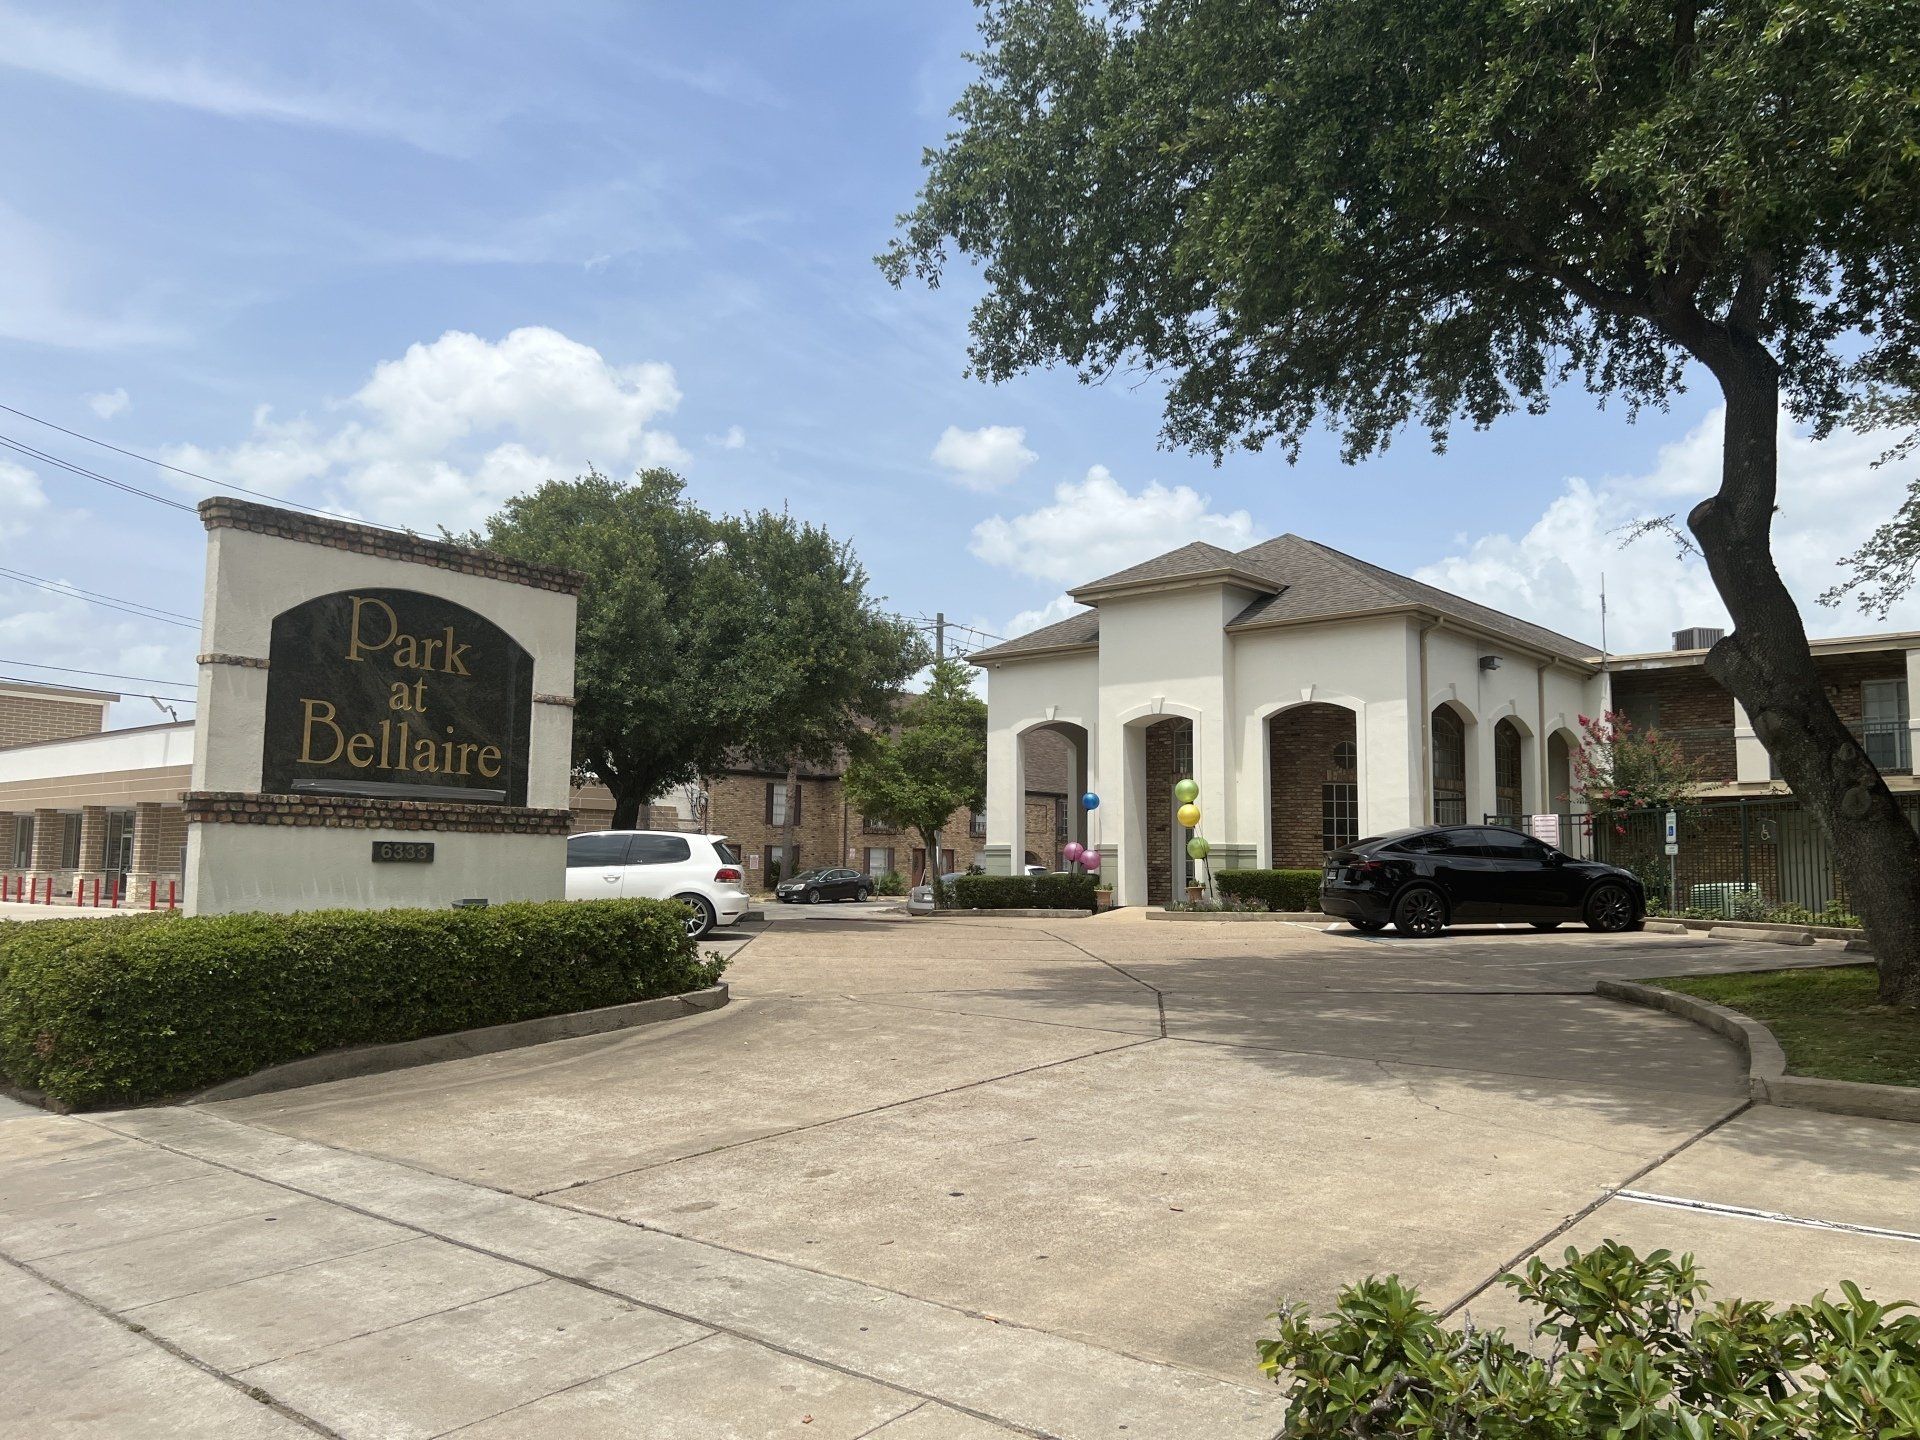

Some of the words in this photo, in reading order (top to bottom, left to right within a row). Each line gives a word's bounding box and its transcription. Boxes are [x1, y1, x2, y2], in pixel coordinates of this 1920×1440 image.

[345, 596, 471, 676] Park
[389, 676, 427, 713] at
[296, 698, 502, 778] Bellaire
[381, 843, 427, 859] 6333
